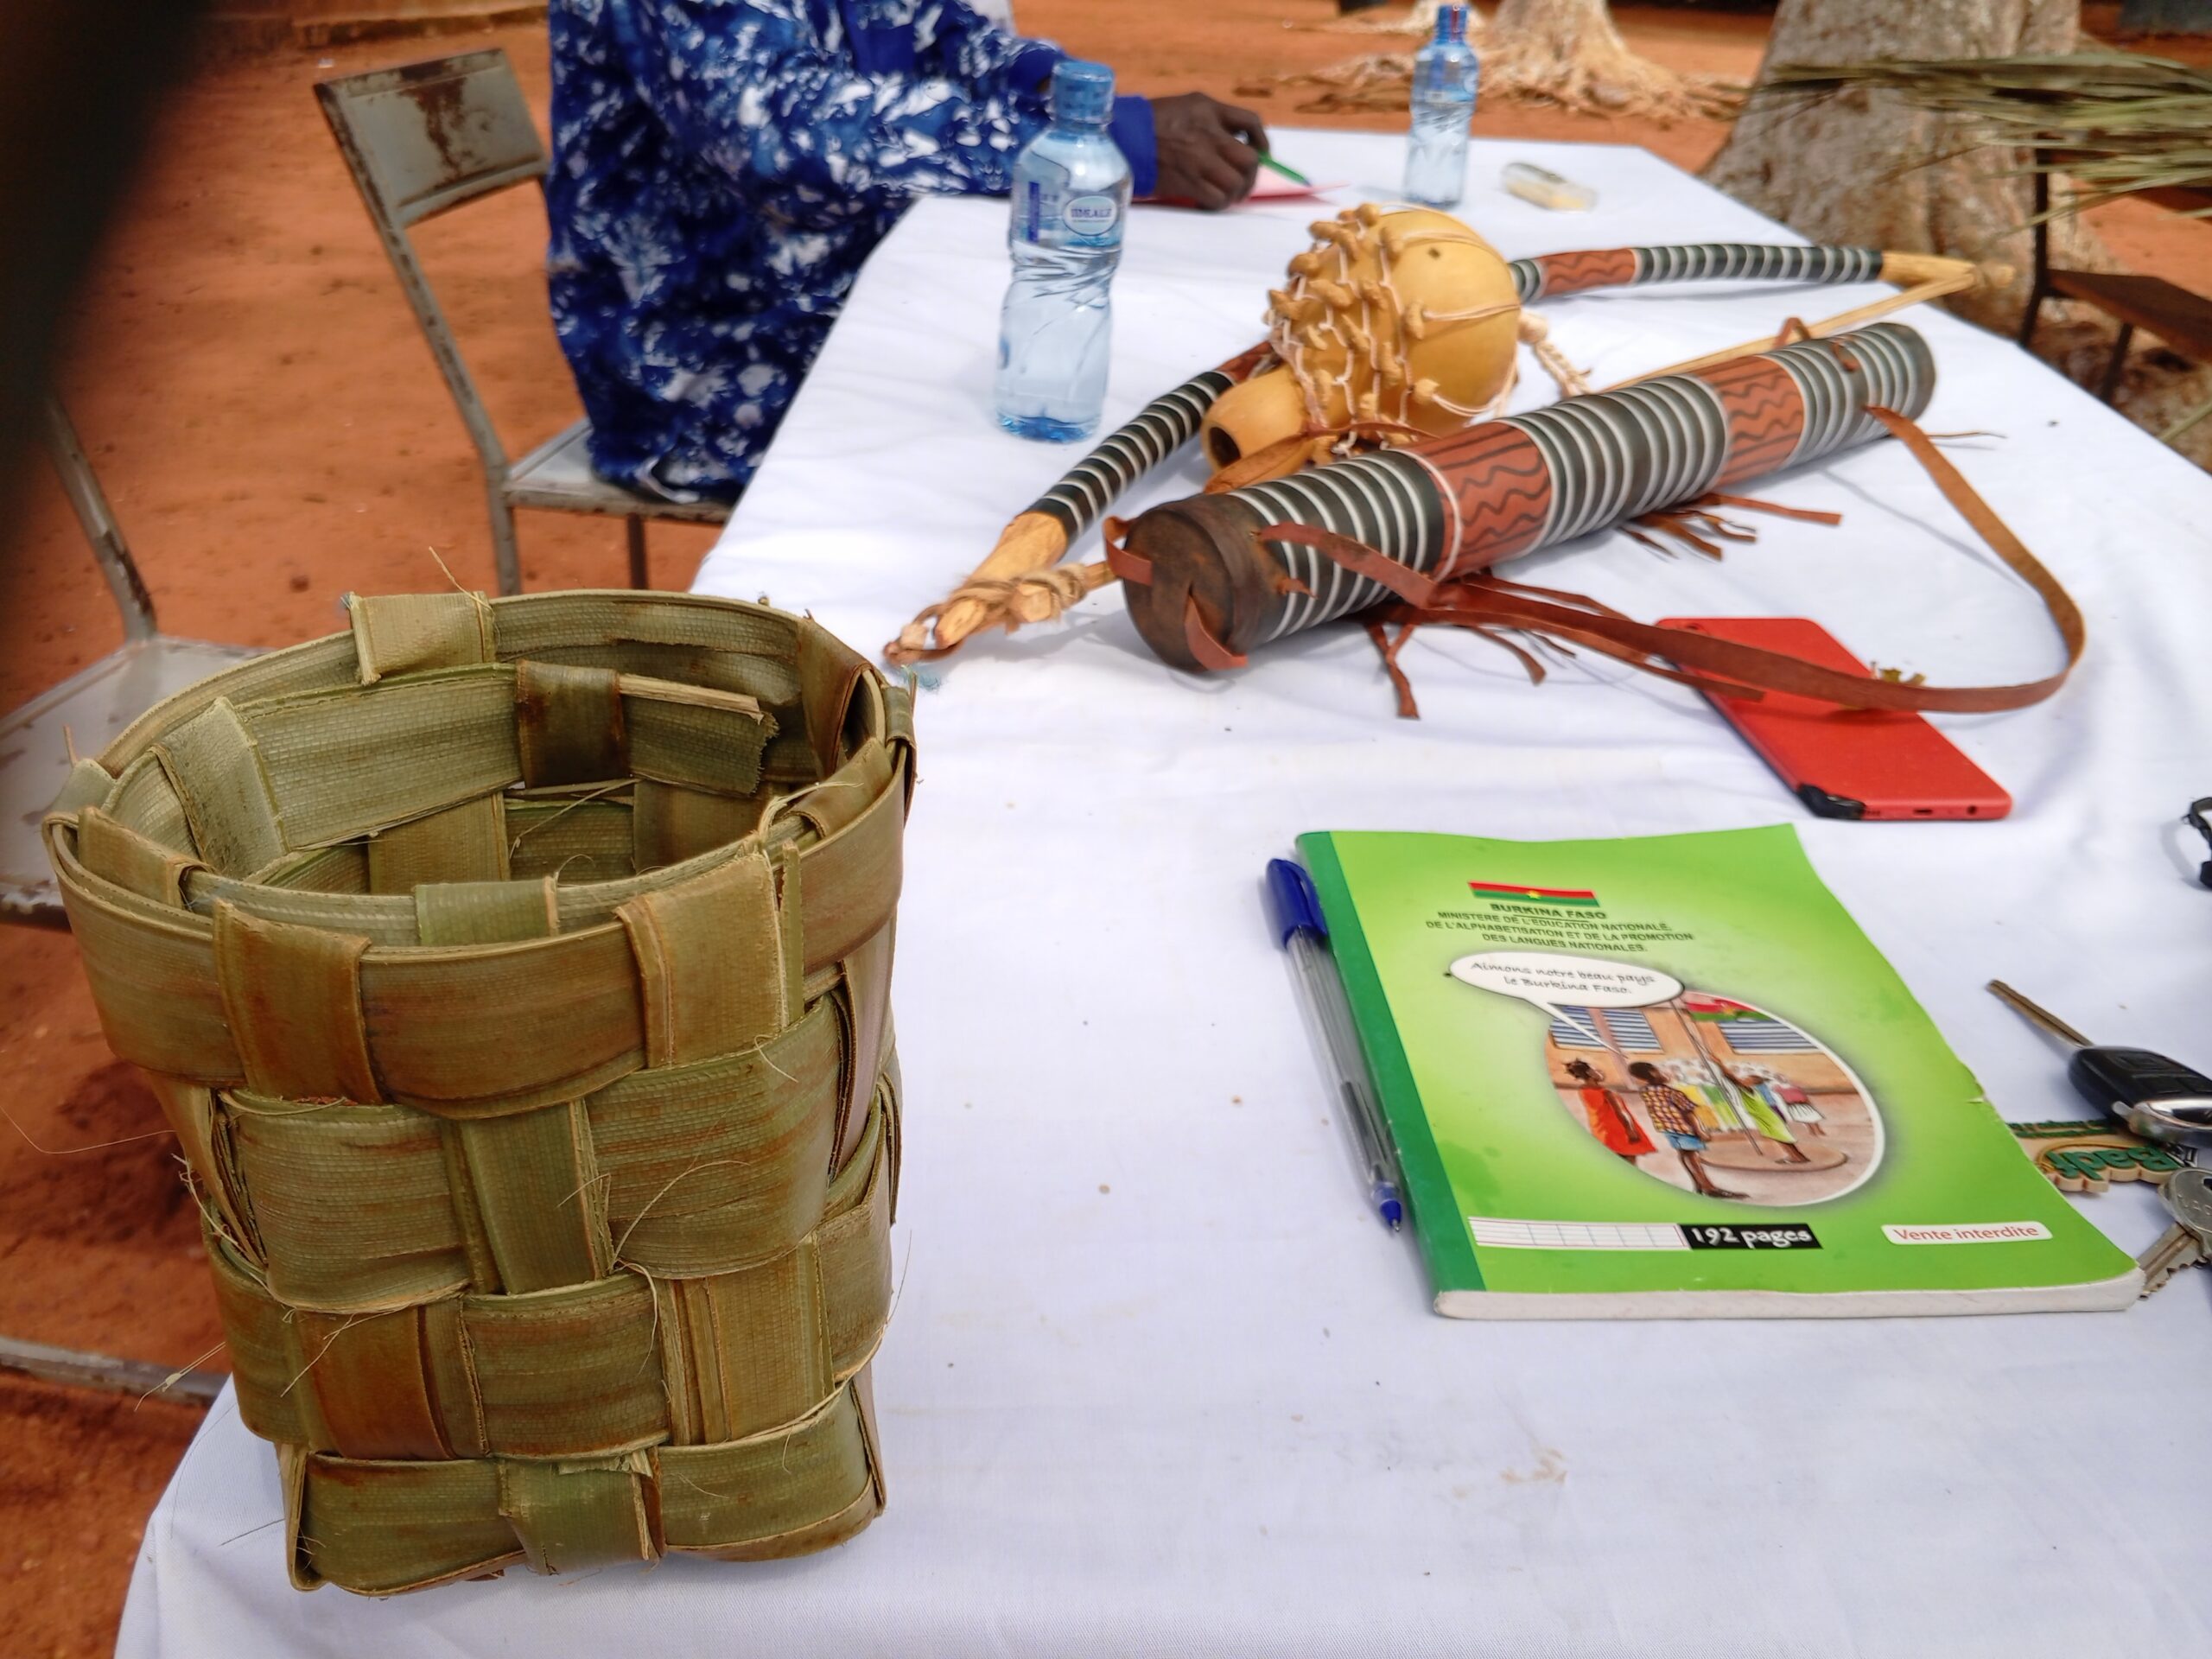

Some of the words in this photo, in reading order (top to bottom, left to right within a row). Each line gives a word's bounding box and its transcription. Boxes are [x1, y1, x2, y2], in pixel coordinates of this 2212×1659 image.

[1490, 903, 1563, 918] BURKINA
[1567, 910, 1607, 919] FASO
[1503, 916, 1519, 925] DE
[1426, 920, 1442, 929] DE
[1567, 931, 1583, 940] ET
[1584, 932, 1601, 941] DE
[1622, 933, 1694, 942] PROMOTION
[1482, 933, 1506, 942] DES
[1510, 935, 1567, 948] LANGUES
[1471, 962, 1532, 974] Aimons
[1535, 969, 1573, 979] notre
[1578, 970, 1613, 982] beau
[1618, 976, 1657, 987] pays
[1504, 976, 1517, 986] le
[1521, 978, 1588, 991] Burkina
[1691, 1227, 1740, 1246] 192
[1740, 1230, 1813, 1249] pages
[1892, 1228, 1953, 1241] Vente
[1954, 1226, 2040, 1239] interdite
